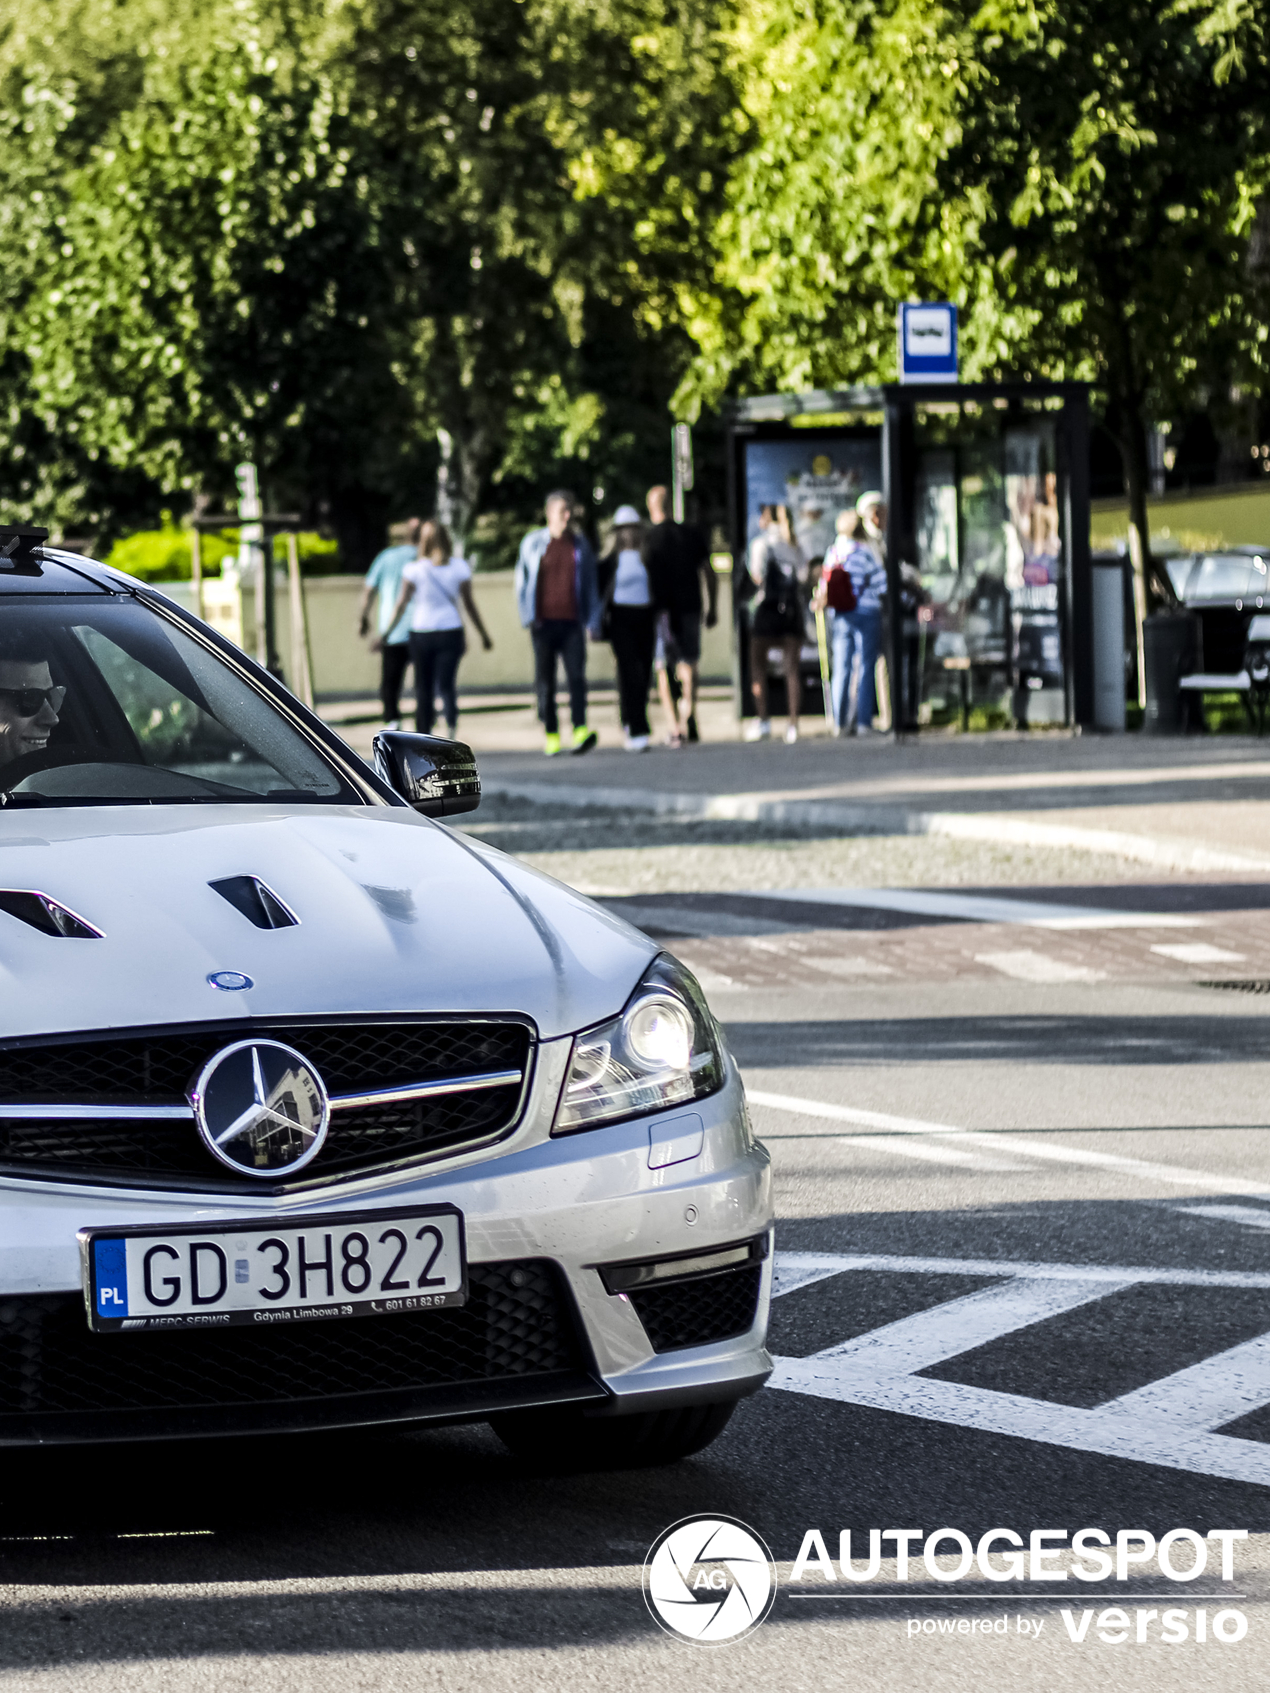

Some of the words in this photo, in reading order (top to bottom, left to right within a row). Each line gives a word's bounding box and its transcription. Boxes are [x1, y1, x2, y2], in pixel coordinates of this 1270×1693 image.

[143, 1242, 228, 1306] GD
[257, 1225, 446, 1300] 3H822
[100, 1286, 124, 1306] PL
[385, 1299, 403, 1310] 601
[406, 1298, 418, 1308] 61
[420, 1296, 433, 1306] 82
[434, 1295, 447, 1305] 67
[253, 1309, 291, 1323] Gdynia
[293, 1305, 339, 1319] Limbowa
[341, 1305, 353, 1315] 29
